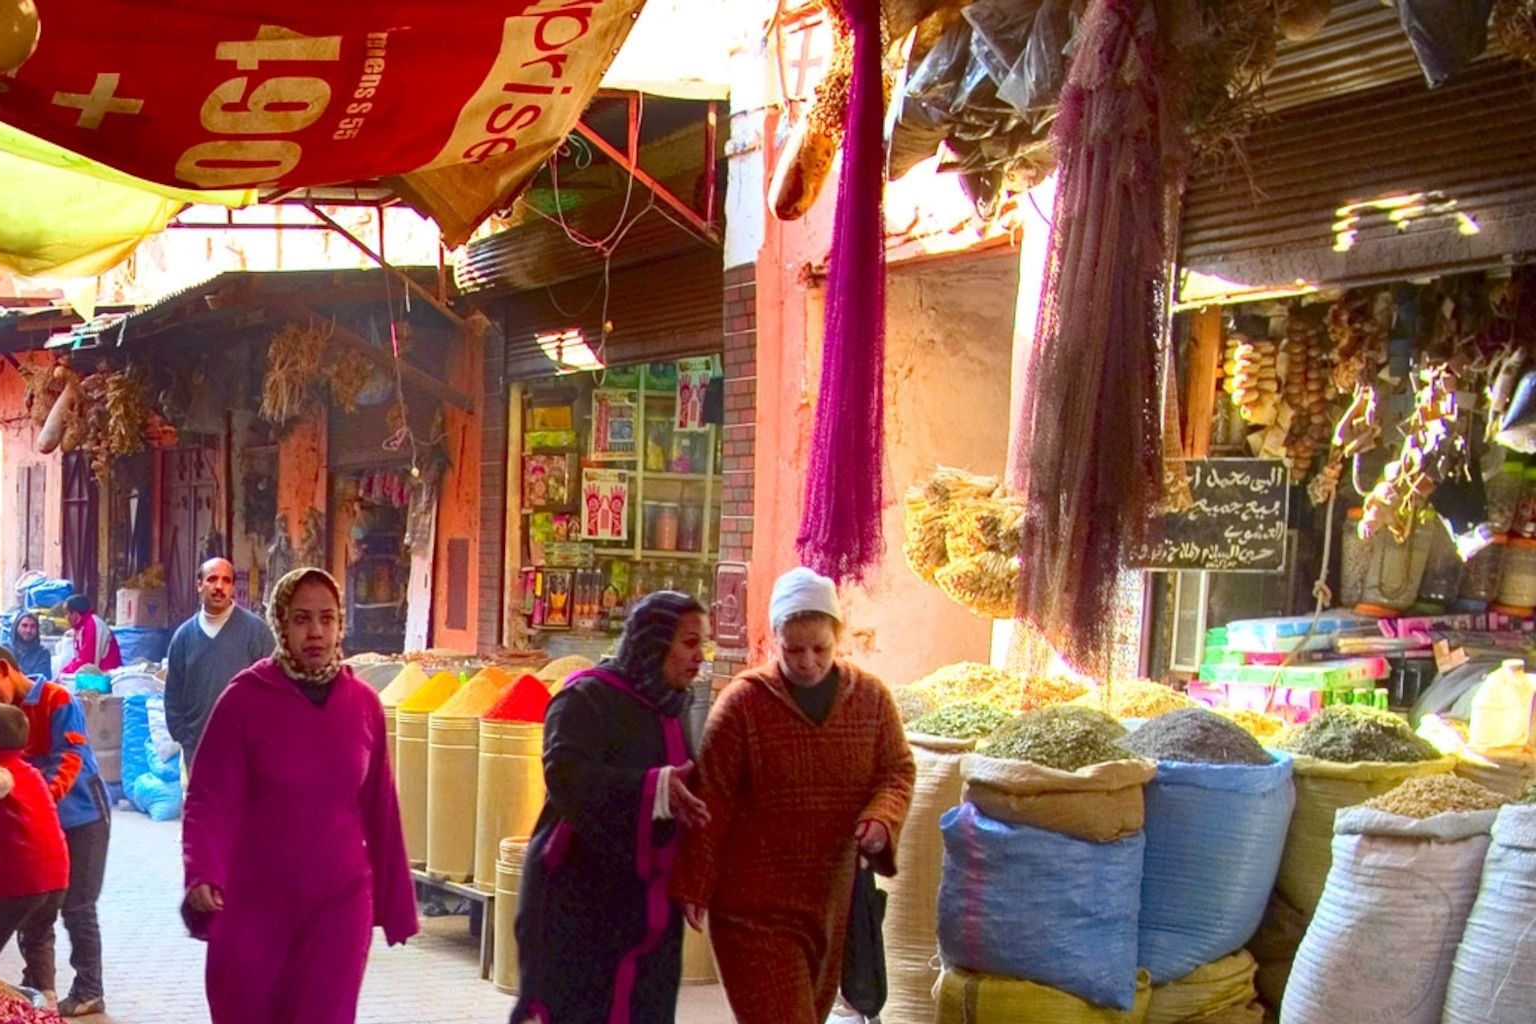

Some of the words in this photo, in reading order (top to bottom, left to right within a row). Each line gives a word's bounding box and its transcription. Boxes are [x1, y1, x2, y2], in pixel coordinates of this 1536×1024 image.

[353, 32, 389, 98] mens
[463, 0, 601, 164] prise
[332, 117, 366, 141] 55
[345, 101, 373, 115] S
